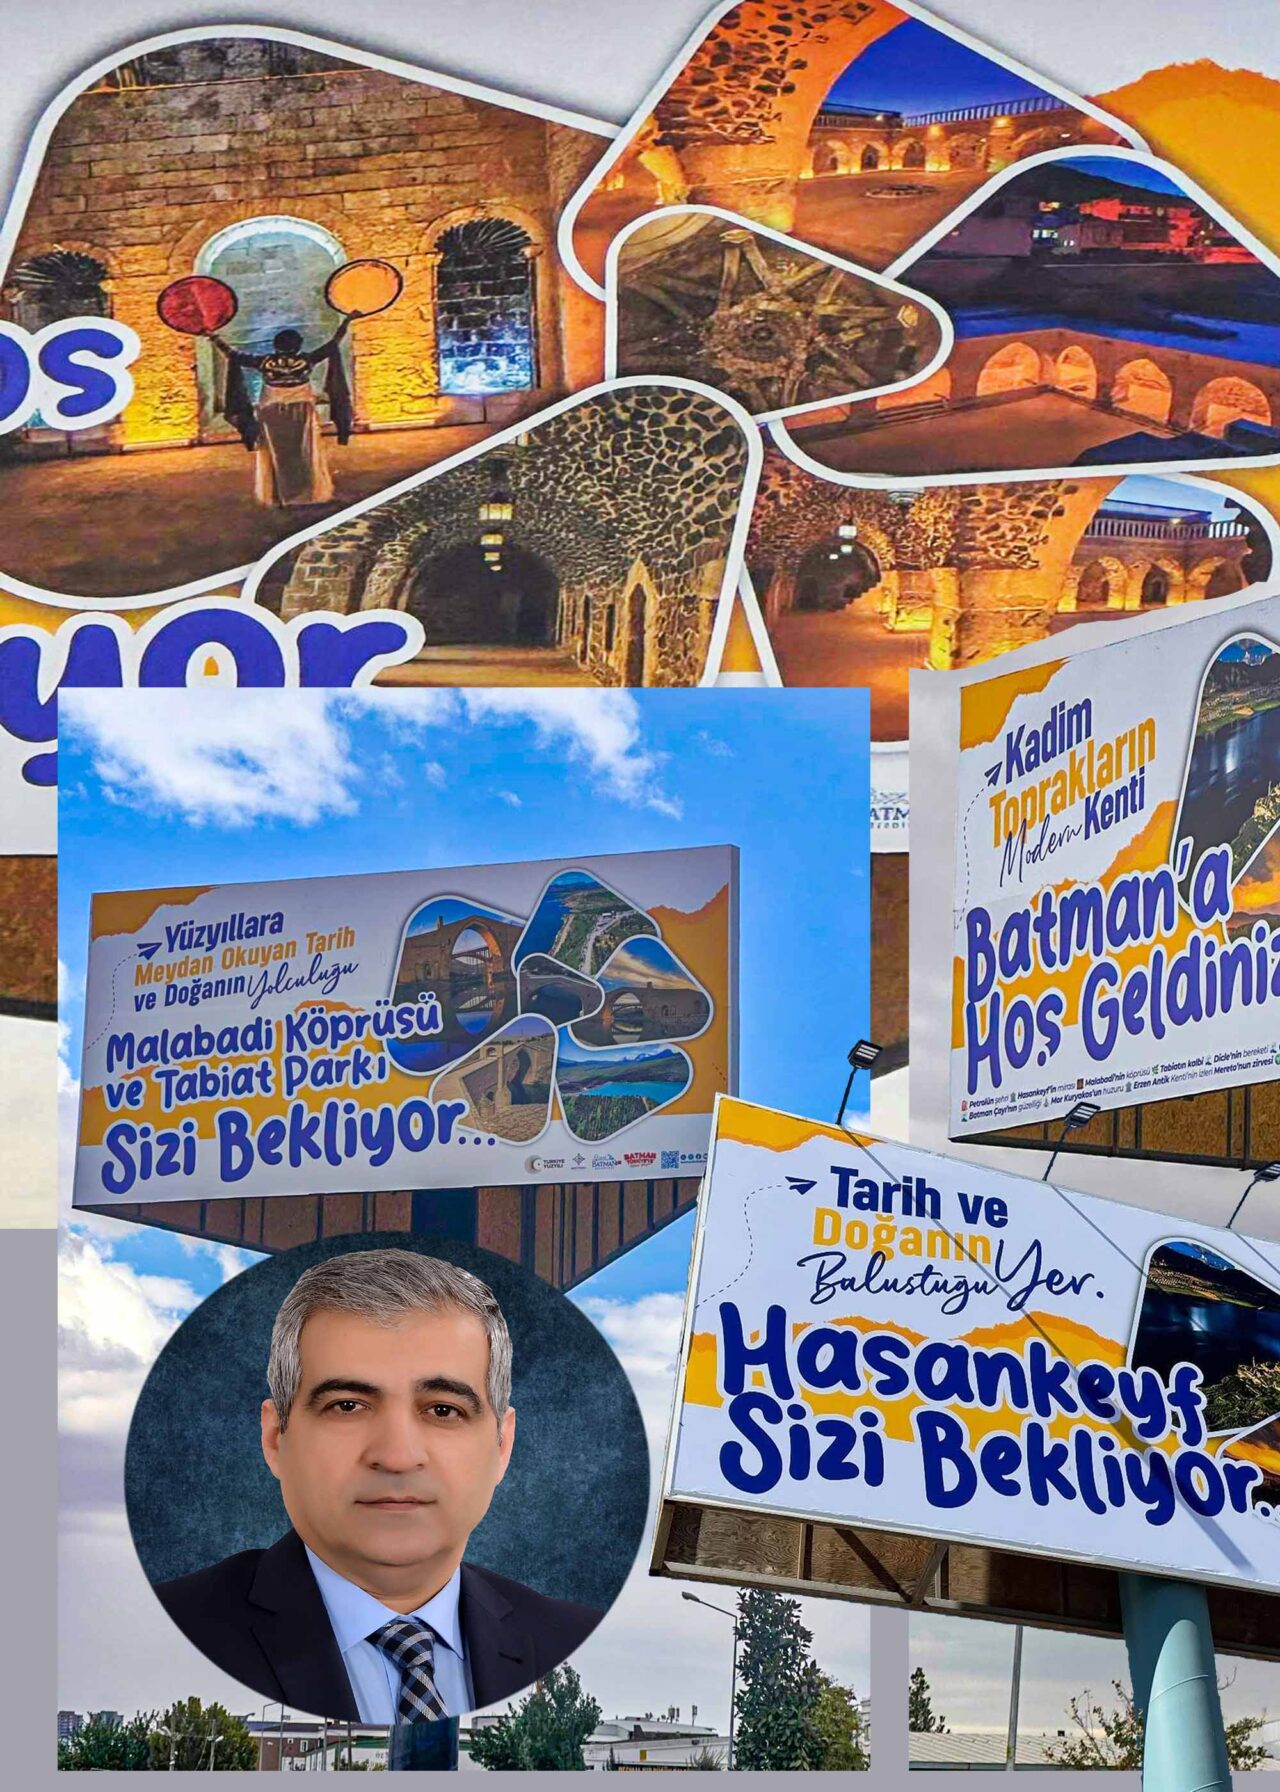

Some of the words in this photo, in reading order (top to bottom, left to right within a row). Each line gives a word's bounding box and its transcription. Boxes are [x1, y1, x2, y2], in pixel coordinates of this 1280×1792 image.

[988, 717, 1156, 849] Toprakların
[1005, 698, 1093, 786] Kadim
[999, 813, 1084, 888] Modern
[1083, 769, 1145, 842] Kenti
[133, 955, 214, 988] Meydan
[221, 940, 297, 977] Okuyan
[306, 927, 356, 956] Tarih
[164, 911, 285, 955] Yüzyıllara
[966, 841, 1230, 1003] Batman'a
[134, 990, 157, 1013] ve
[164, 975, 246, 1010] Doğanın
[247, 953, 360, 1010] Yolculuğu
[106, 1017, 273, 1074] Malabadi
[285, 992, 441, 1053] Köprüsü
[967, 991, 1063, 1096] Hoş
[106, 1079, 143, 1109] ve
[155, 1060, 273, 1110] Tabiat
[284, 1048, 387, 1097] Parkı
[101, 1120, 197, 1196] Sizi
[218, 1099, 497, 1184] Bekliyor...
[813, 1206, 992, 1265] Doğanın
[830, 1166, 941, 1221] Tarih
[957, 1191, 1009, 1229] ve
[994, 1238, 1105, 1311] Yer.
[719, 1301, 1204, 1447] Hasankeyf
[719, 1391, 885, 1495] Sizi
